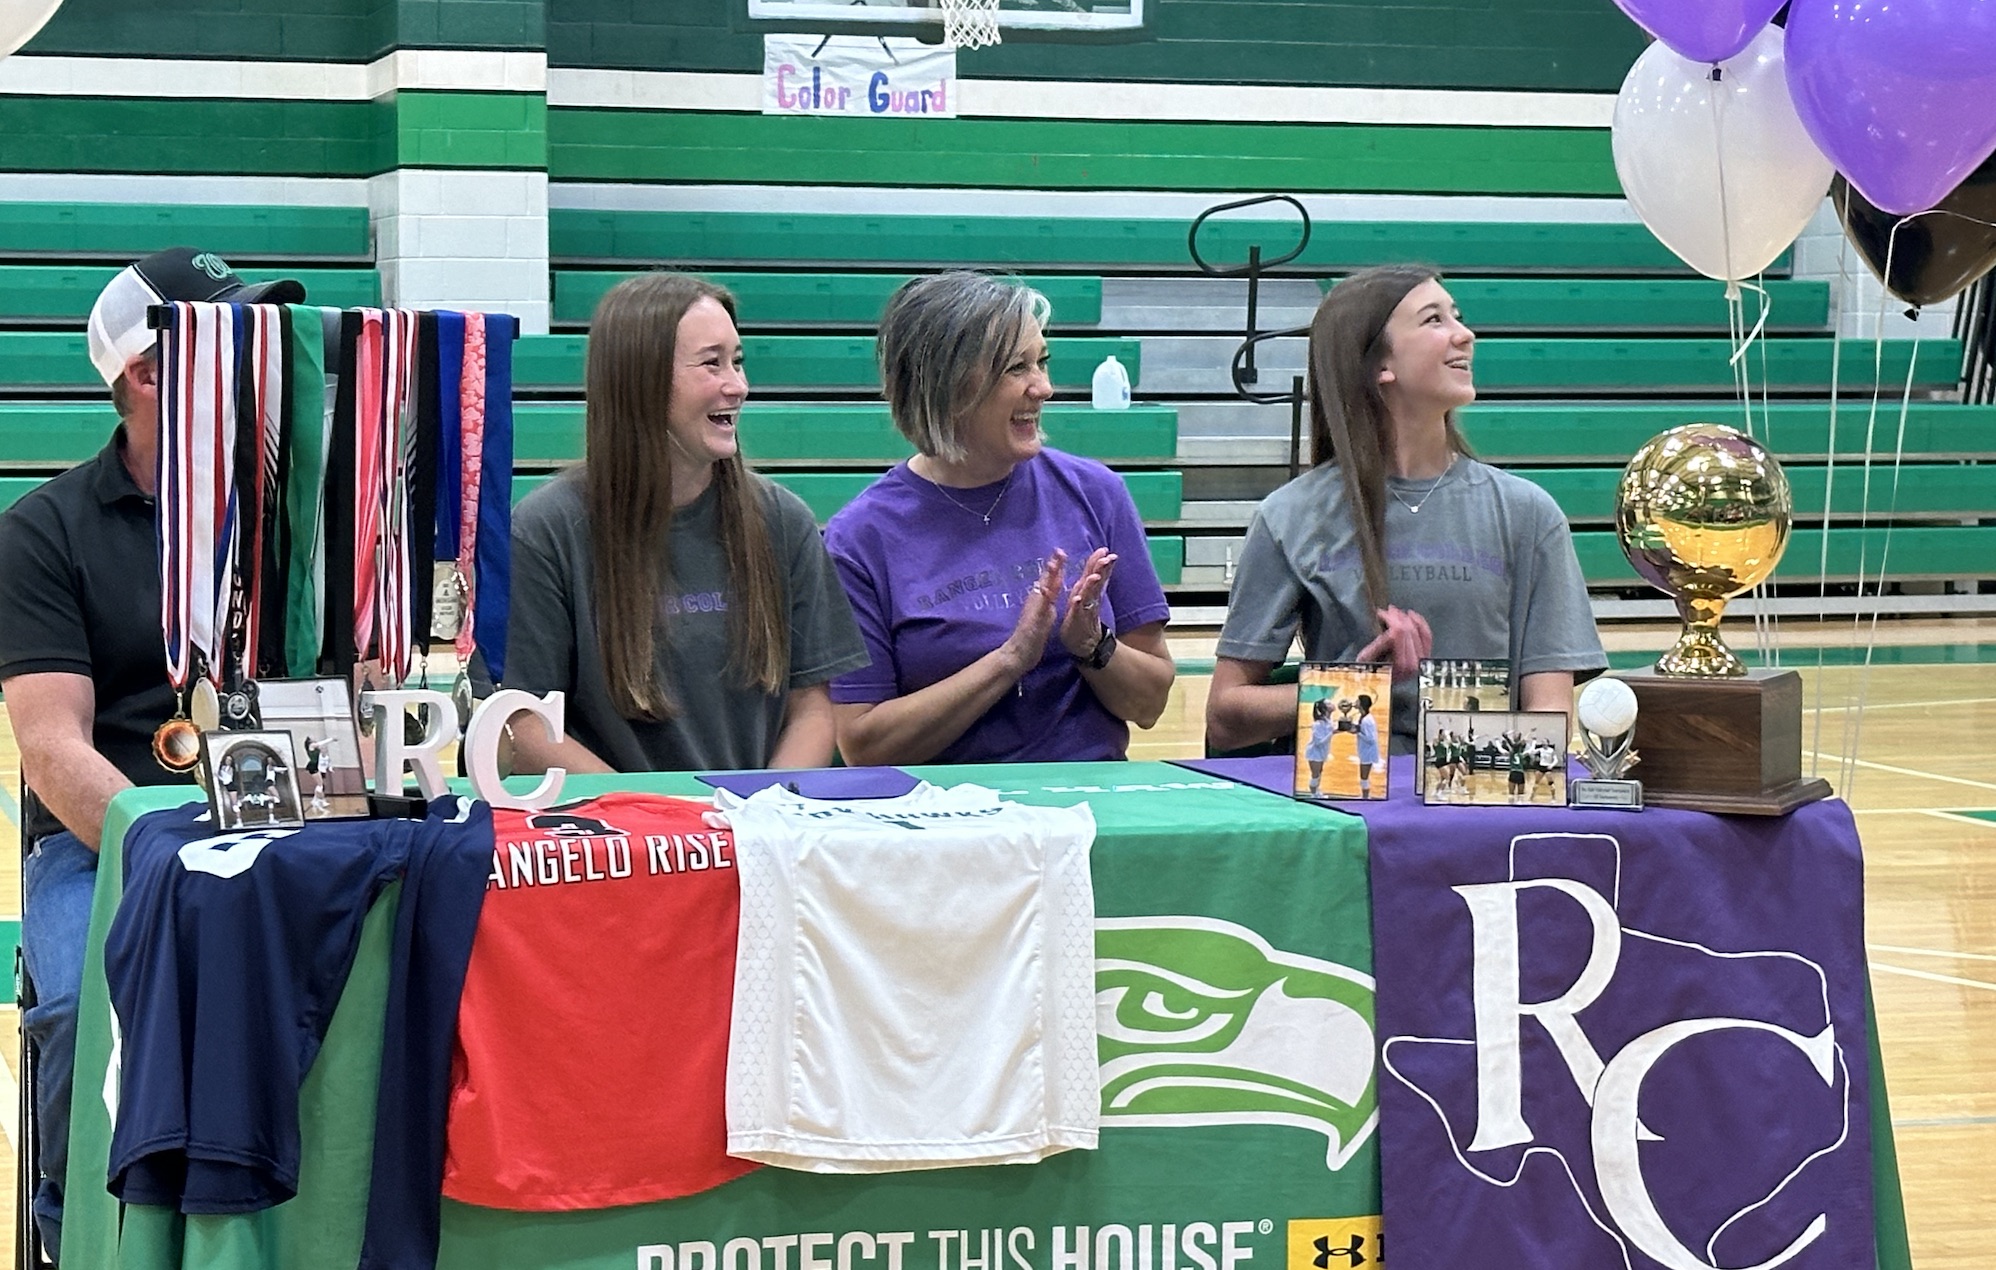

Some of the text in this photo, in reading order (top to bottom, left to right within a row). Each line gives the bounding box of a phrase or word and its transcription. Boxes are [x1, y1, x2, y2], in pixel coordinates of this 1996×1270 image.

[777, 64, 946, 113] Color Guard
[918, 570, 1000, 610] RANGE
[1353, 564, 1472, 582] VLEYBALL
[486, 831, 733, 890] ANGELO RISE
[928, 1226, 1035, 1270] THIS
